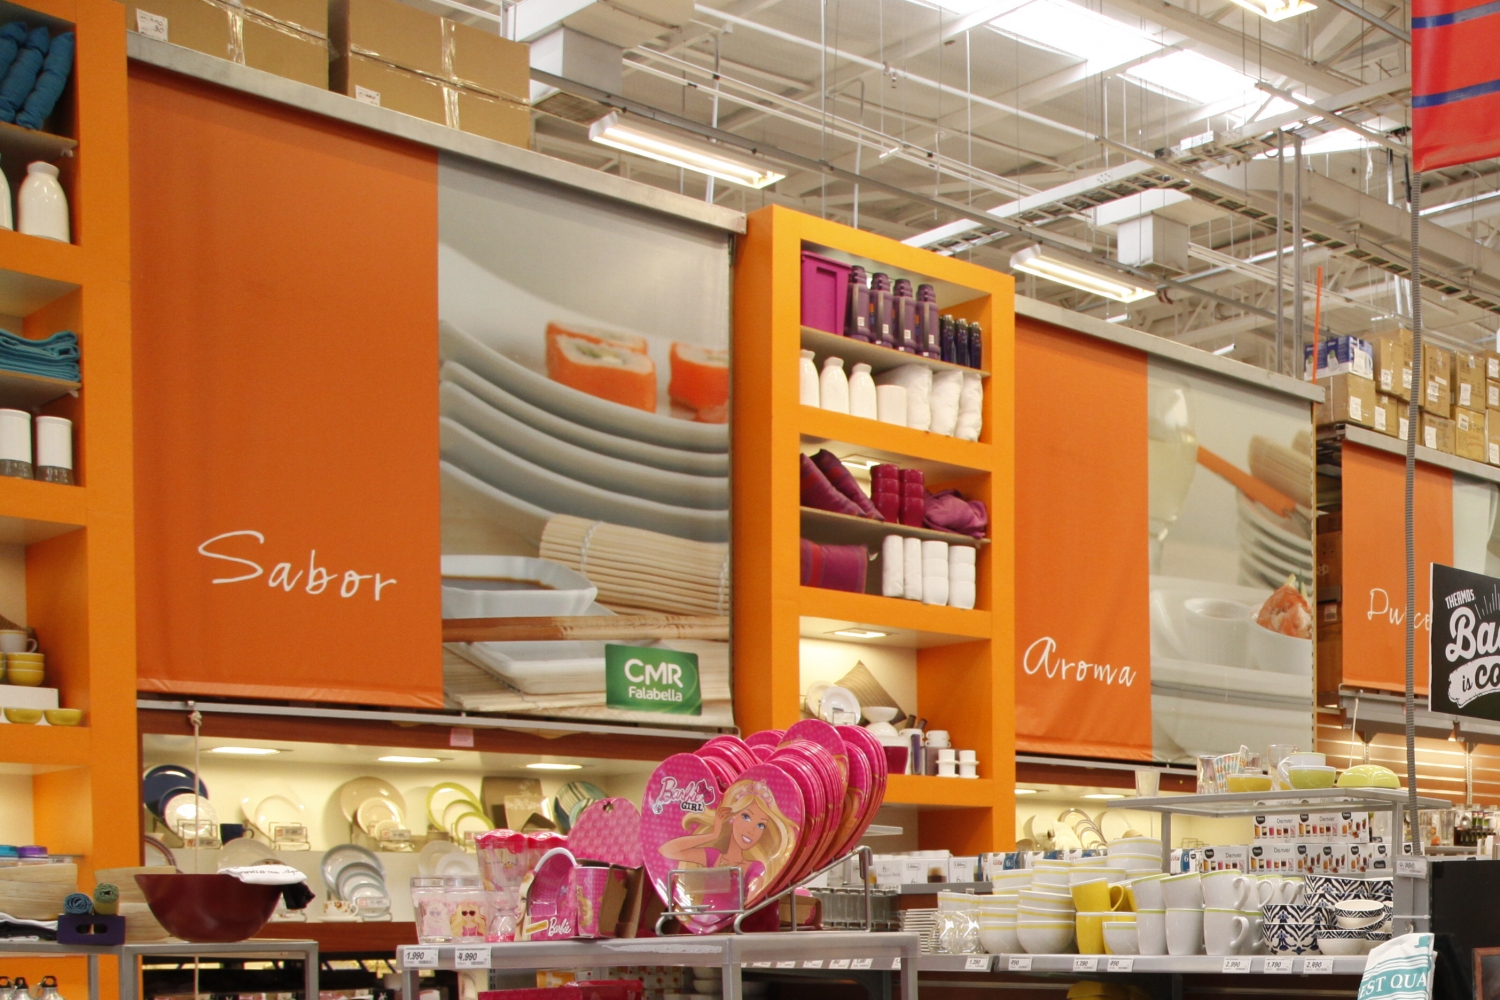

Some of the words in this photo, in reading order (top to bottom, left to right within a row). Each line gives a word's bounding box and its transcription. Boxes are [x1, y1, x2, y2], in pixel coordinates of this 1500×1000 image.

[198, 530, 397, 601] Sabor
[1445, 588, 1475, 609] THERMOS
[1022, 636, 1137, 687] Aroma
[624, 658, 684, 688] CMR
[627, 685, 684, 702] Falabella
[1462, 675, 1473, 693] is
[656, 776, 706, 805] Barbie
[681, 801, 704, 812] GIRL
[1277, 817, 1293, 825] Denver
[1319, 815, 1335, 823] Denver
[547, 916, 572, 937] Barbie
[406, 951, 425, 960] 1.990
